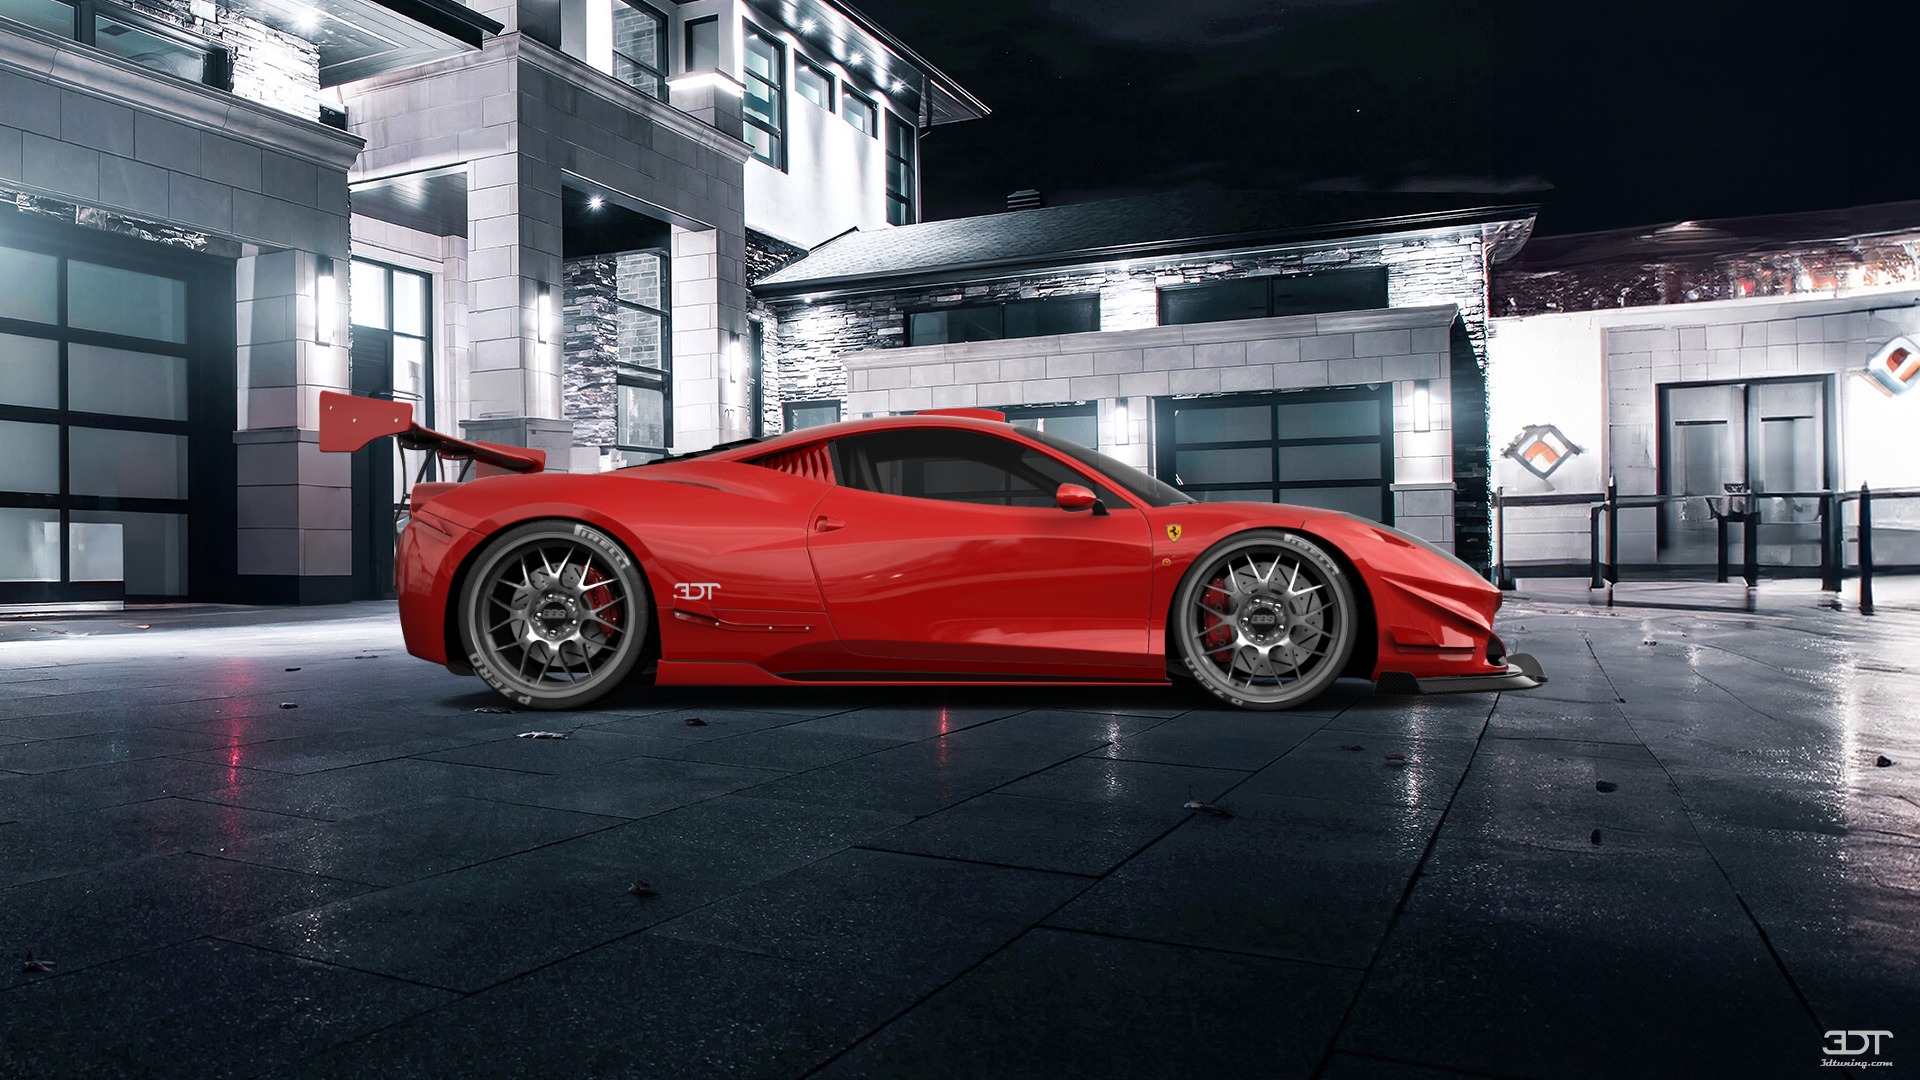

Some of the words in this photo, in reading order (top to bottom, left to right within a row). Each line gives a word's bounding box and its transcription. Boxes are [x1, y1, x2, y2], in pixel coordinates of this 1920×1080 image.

[573, 523, 631, 569] PIRELLI
[673, 582, 721, 600] 3DT
[542, 609, 567, 619] BBS
[1250, 614, 1275, 625] BBS
[469, 652, 514, 697] ZERO
[517, 695, 532, 705] P
